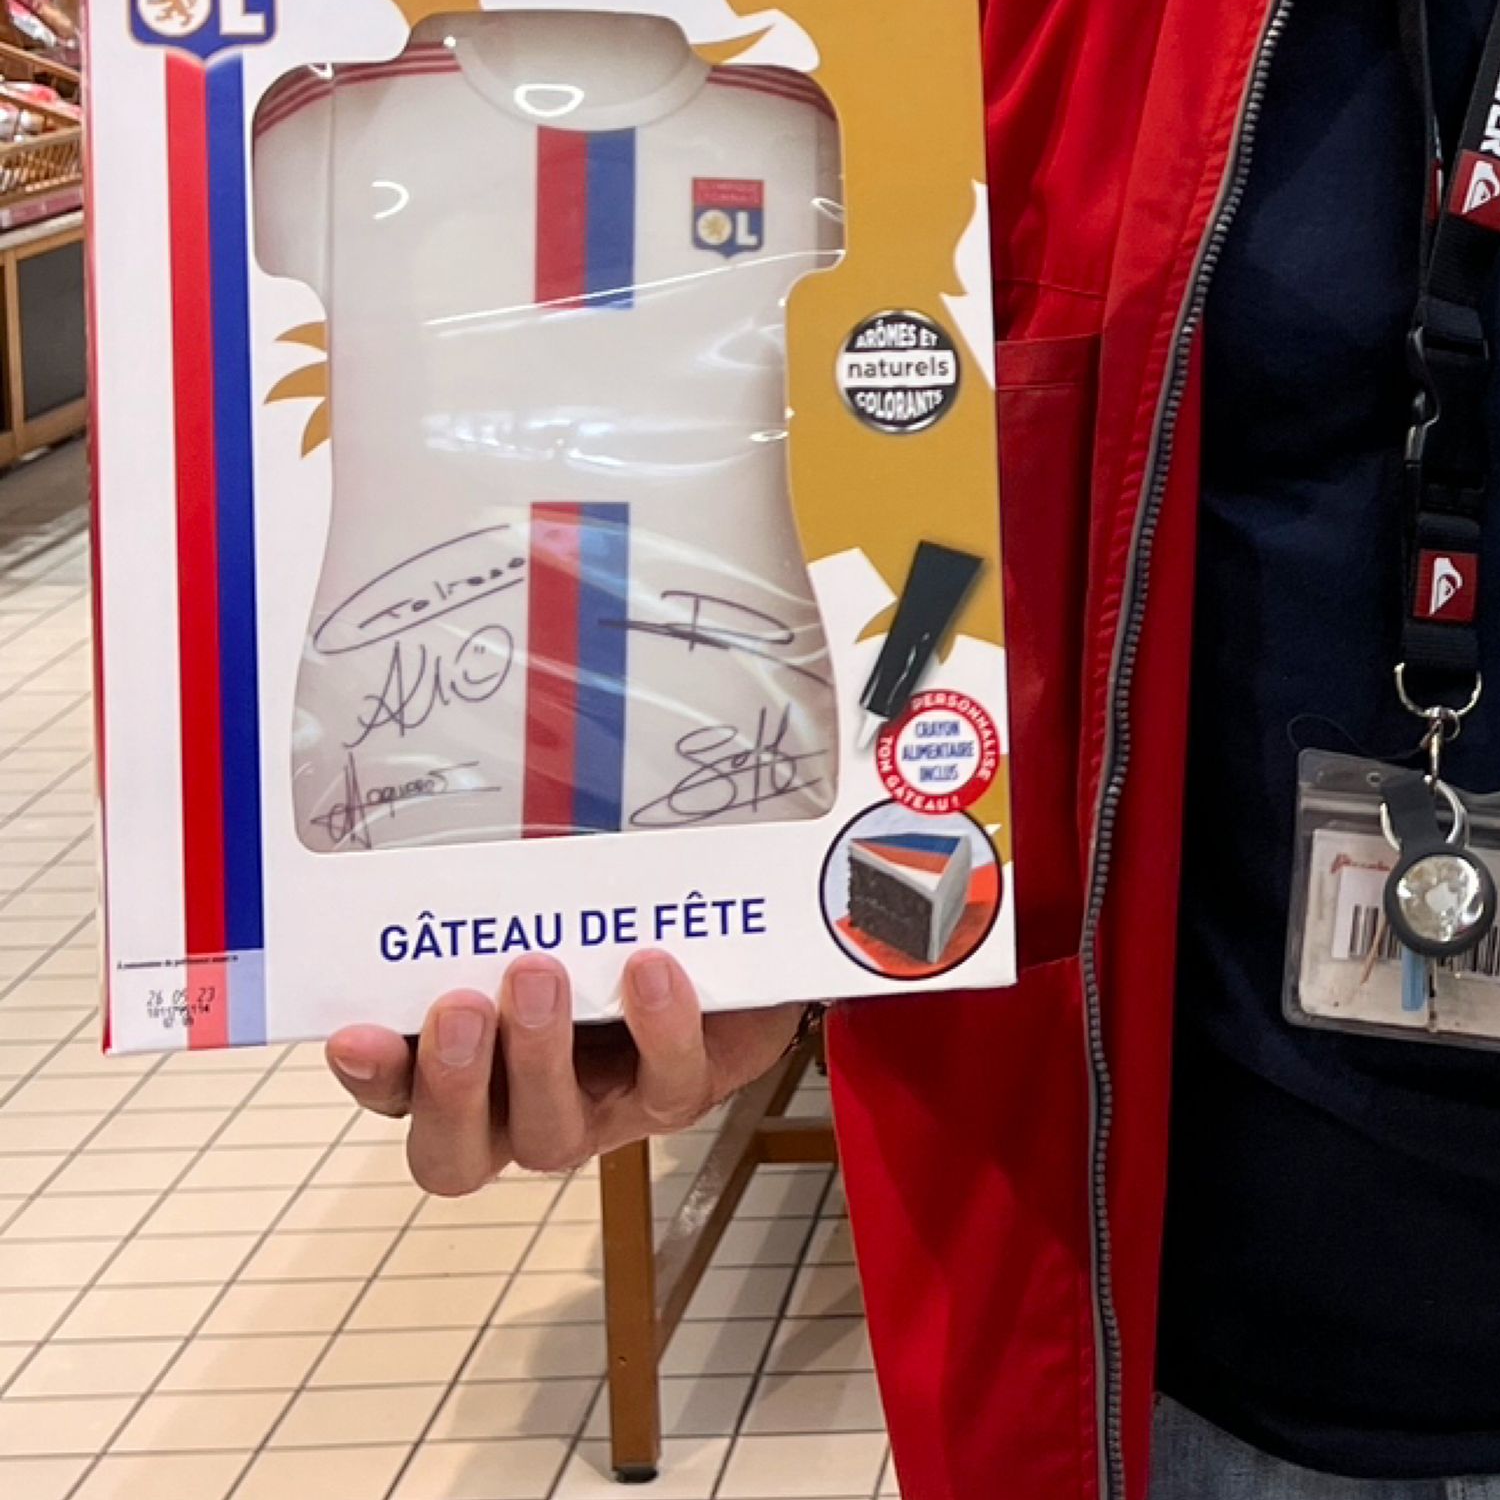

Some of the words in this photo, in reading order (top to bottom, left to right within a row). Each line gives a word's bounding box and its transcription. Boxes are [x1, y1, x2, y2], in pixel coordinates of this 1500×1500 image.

[847, 356, 949, 378] naturels
[855, 388, 945, 421] COLORANTS
[915, 721, 961, 737] CRAYON
[901, 741, 975, 762] ALIMENTAIRE
[379, 910, 563, 963] GÂTEAU
[580, 905, 638, 947] DE
[654, 890, 767, 941] FÊTE
